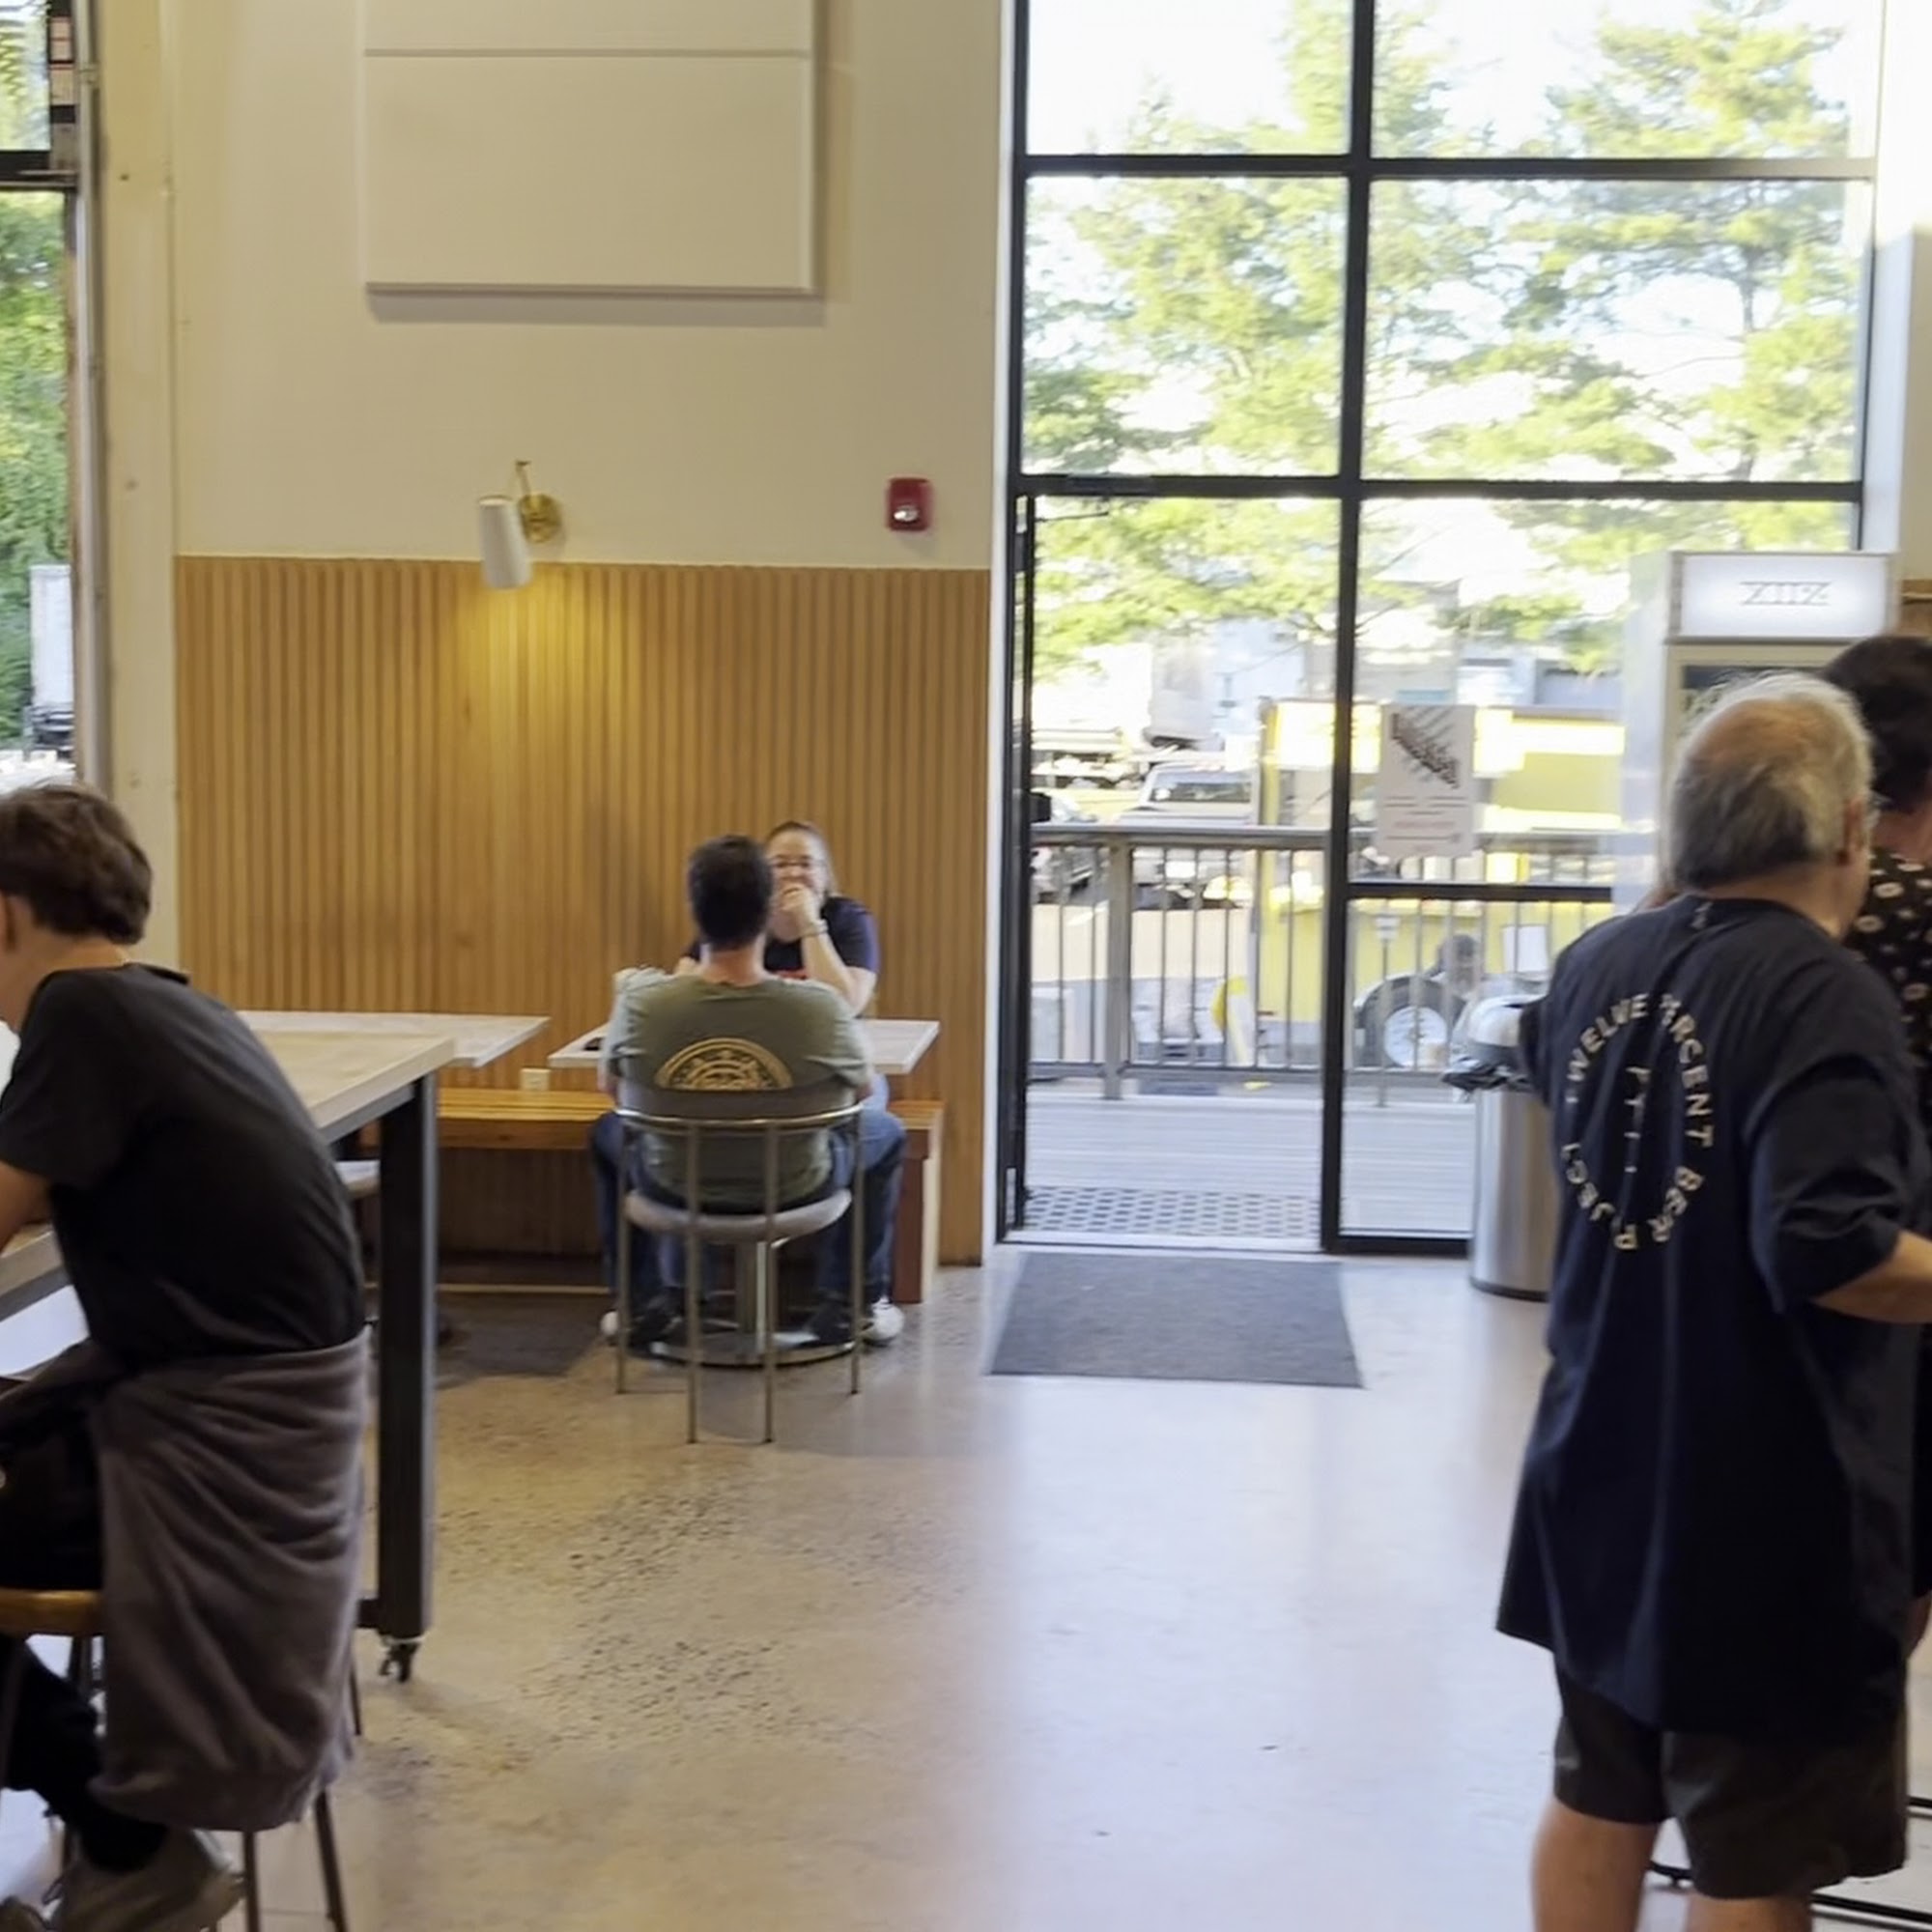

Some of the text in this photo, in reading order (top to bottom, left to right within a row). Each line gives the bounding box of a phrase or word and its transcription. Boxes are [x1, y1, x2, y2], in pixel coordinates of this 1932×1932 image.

[1659, 993, 1714, 1147] RCENT
[1560, 1141, 1638, 1250] PJECT
[1646, 1165, 1705, 1242] BER
